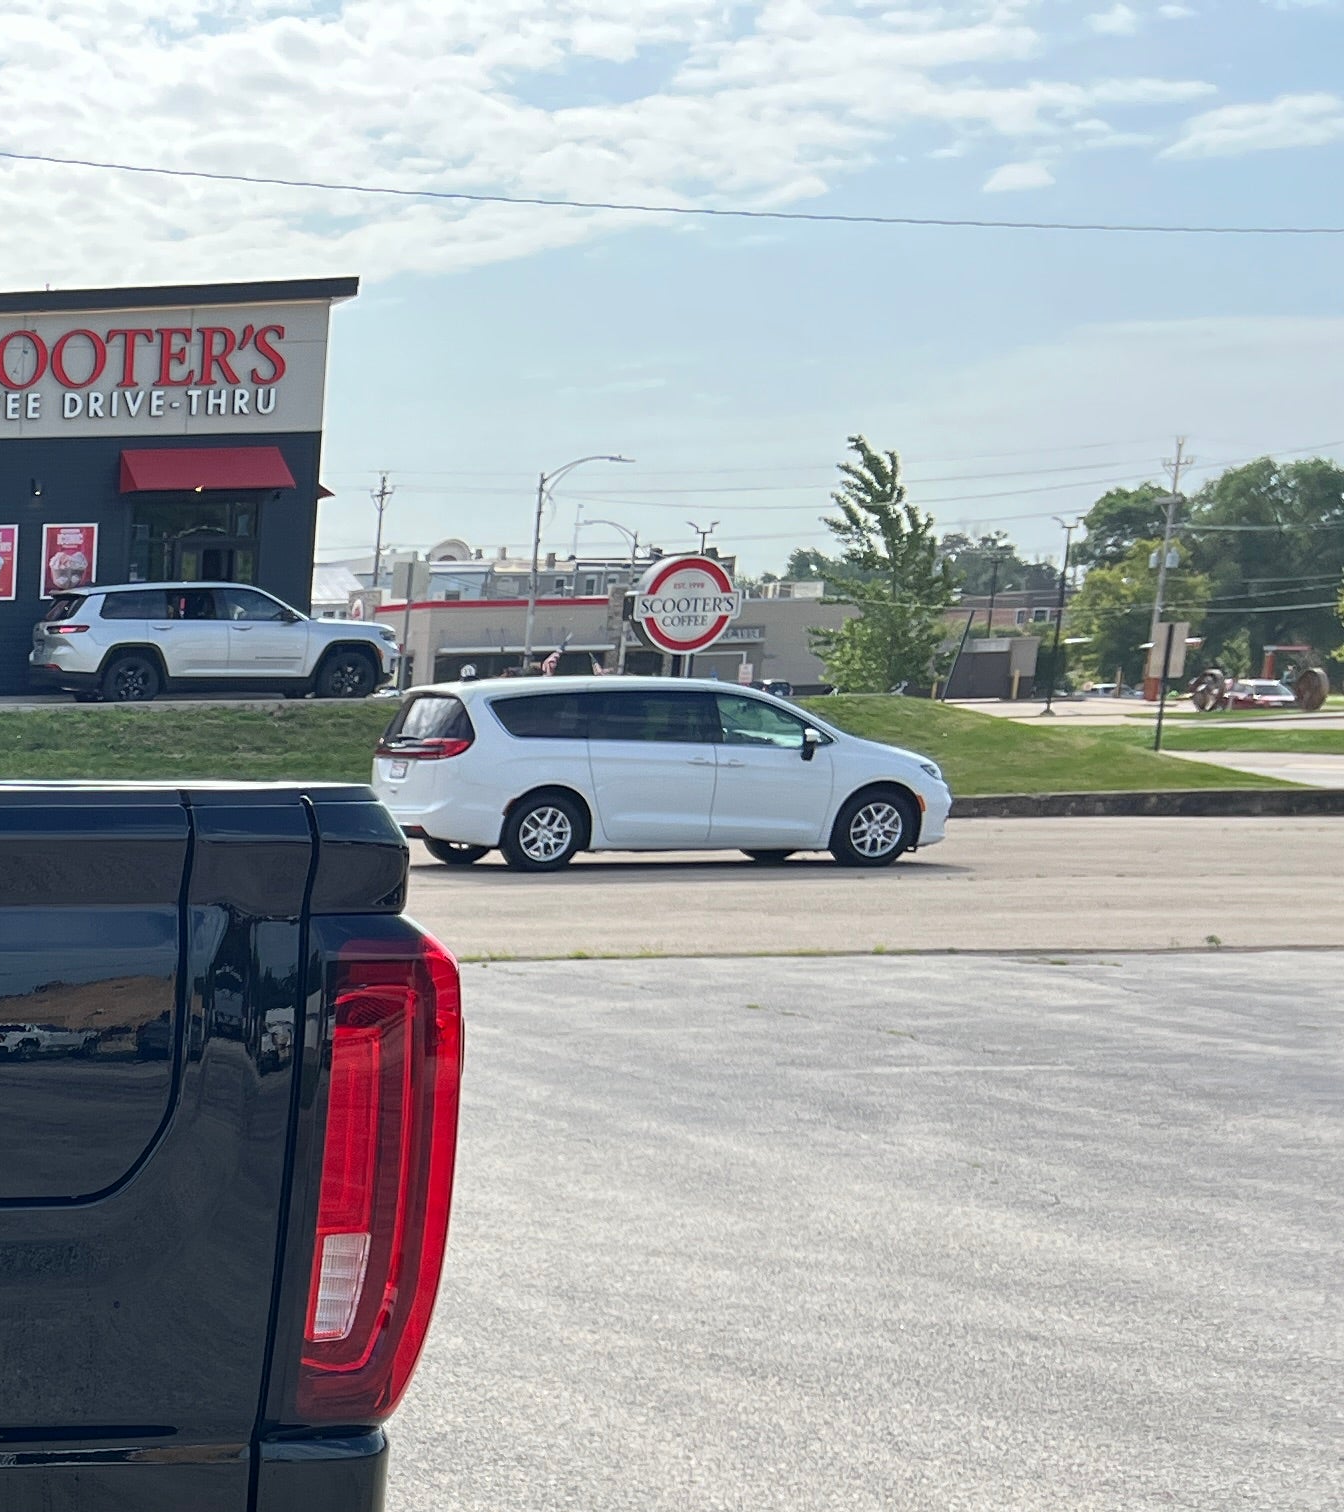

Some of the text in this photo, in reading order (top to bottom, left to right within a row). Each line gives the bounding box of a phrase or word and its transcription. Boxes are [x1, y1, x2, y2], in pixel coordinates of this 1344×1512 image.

[63, 388, 277, 419] DRIVE-THRU
[640, 596, 734, 614] SCOOTER'S
[662, 615, 708, 627] COFFEE
